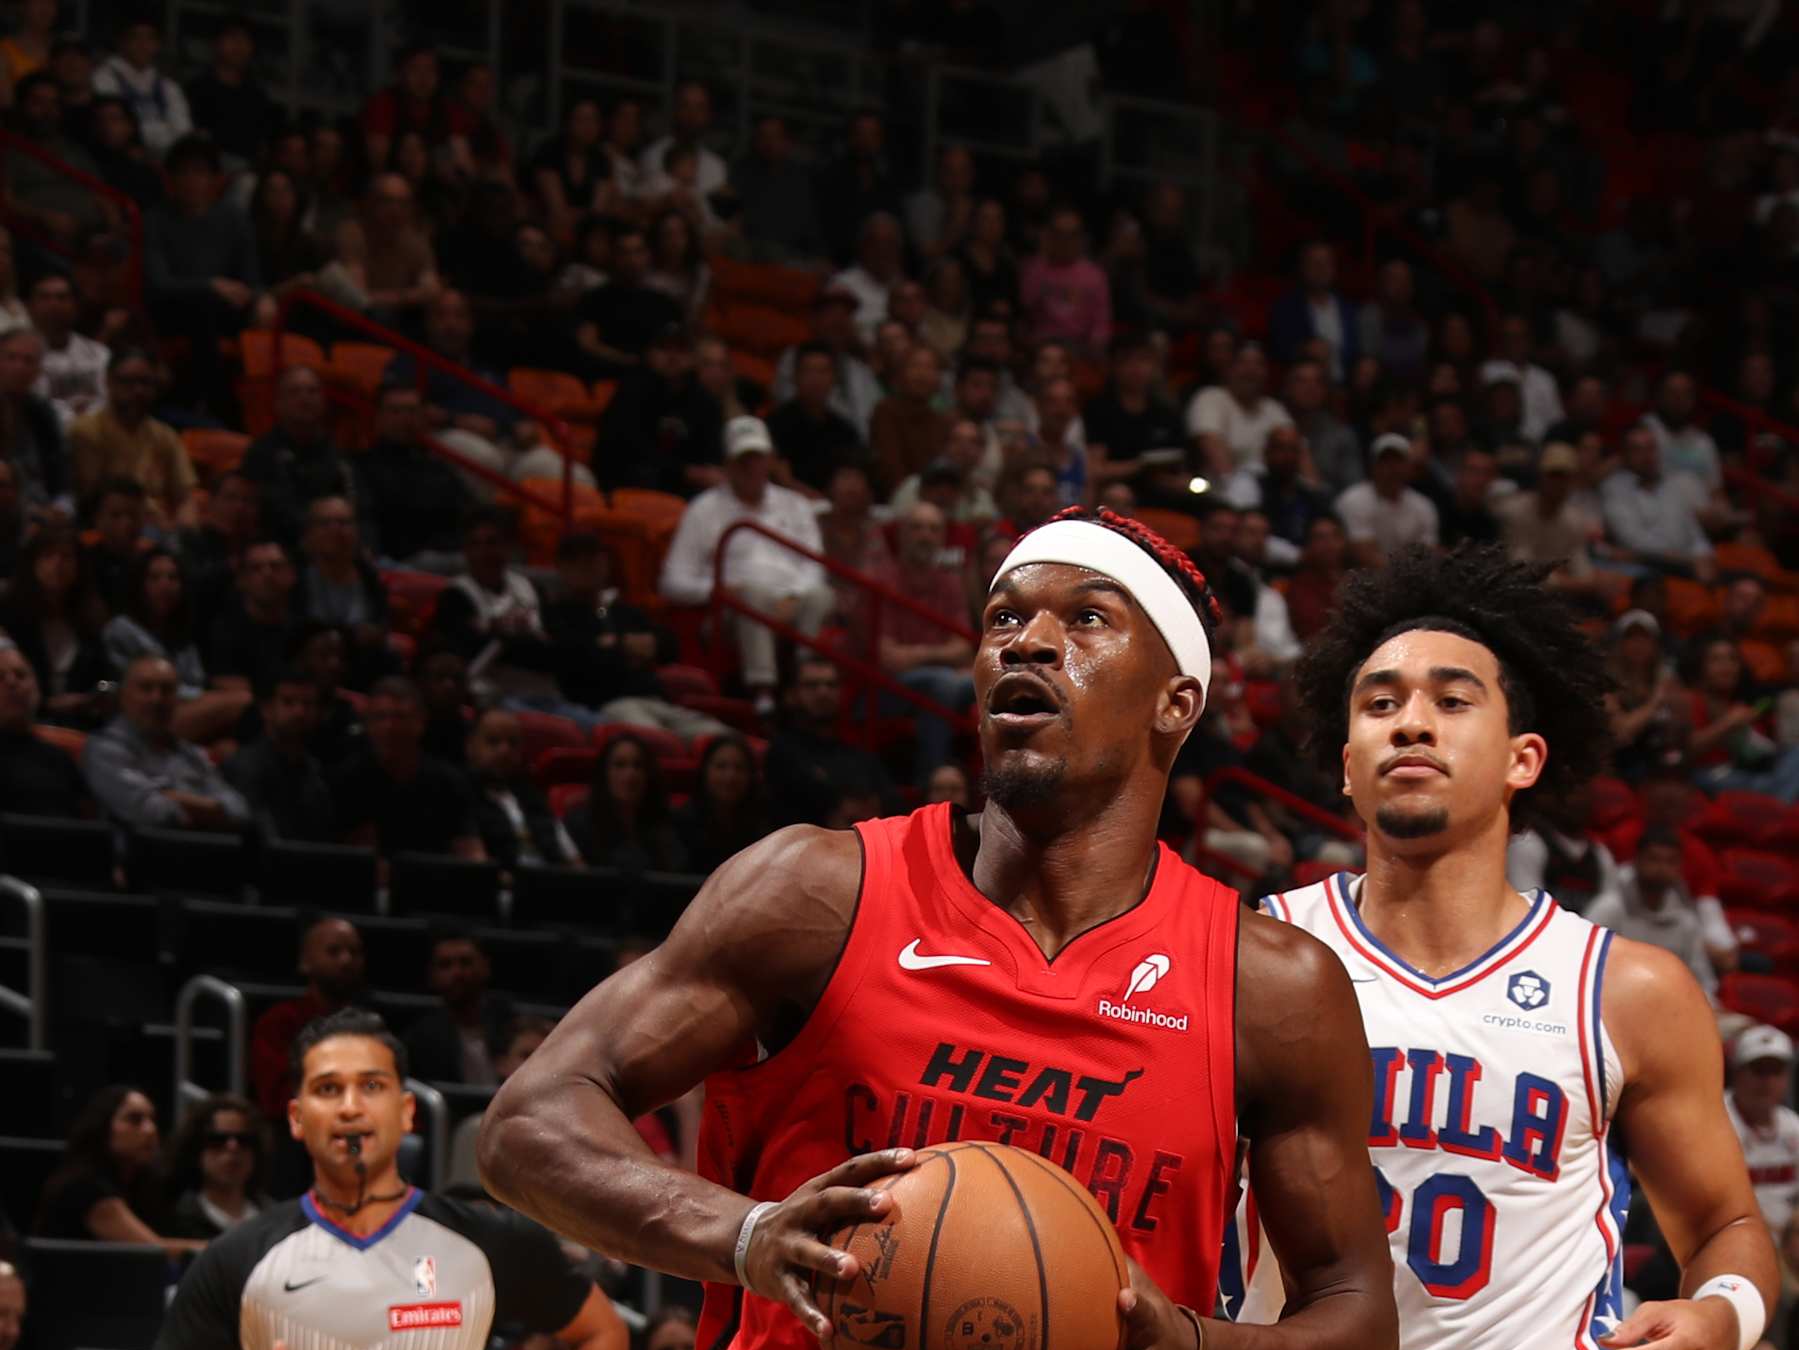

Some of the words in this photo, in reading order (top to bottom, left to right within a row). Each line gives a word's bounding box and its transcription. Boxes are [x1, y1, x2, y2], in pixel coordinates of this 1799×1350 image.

[1098, 1000, 1187, 1031] Robinhood
[1483, 1013, 1567, 1035] crypto.com
[920, 1043, 1144, 1121] HEAT
[1374, 1166, 1496, 1300] 0
[392, 1307, 462, 1327] Emirates
